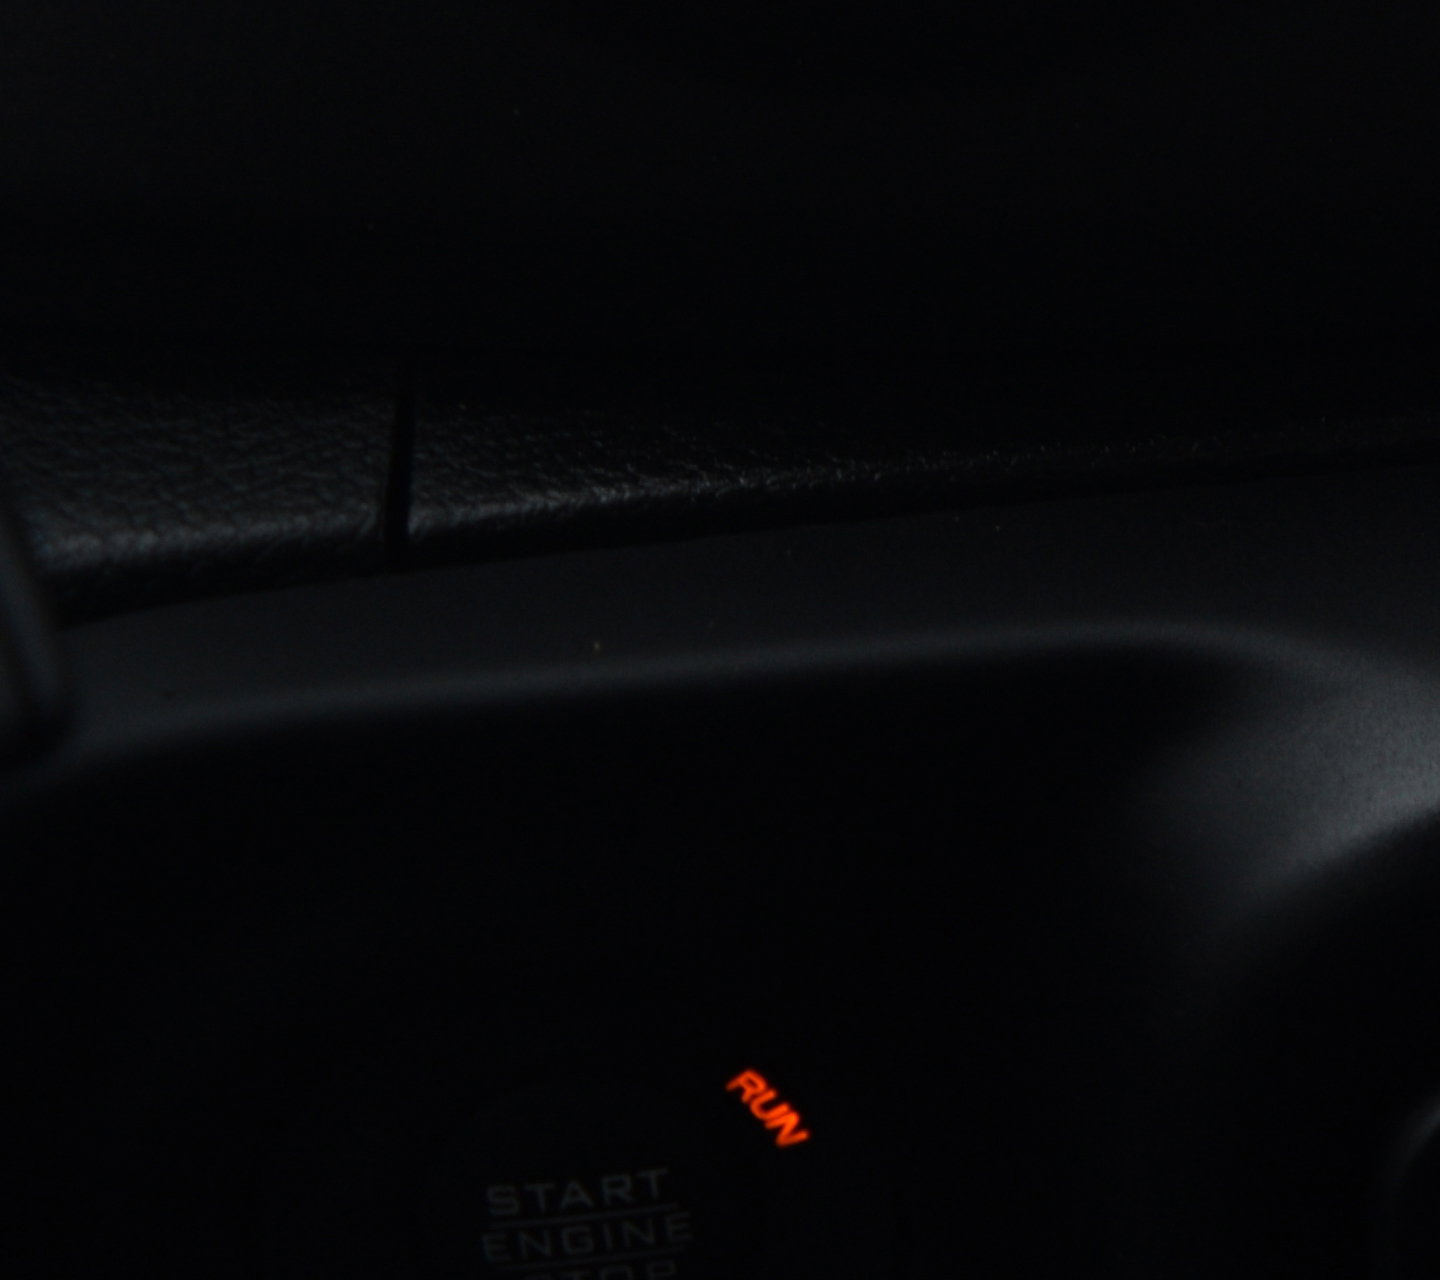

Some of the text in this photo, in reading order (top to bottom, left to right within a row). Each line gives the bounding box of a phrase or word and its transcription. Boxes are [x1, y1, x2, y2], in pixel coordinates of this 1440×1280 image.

[725, 1068, 811, 1148] RUN
[484, 1165, 670, 1218] START
[478, 1209, 694, 1265] ENGINE
